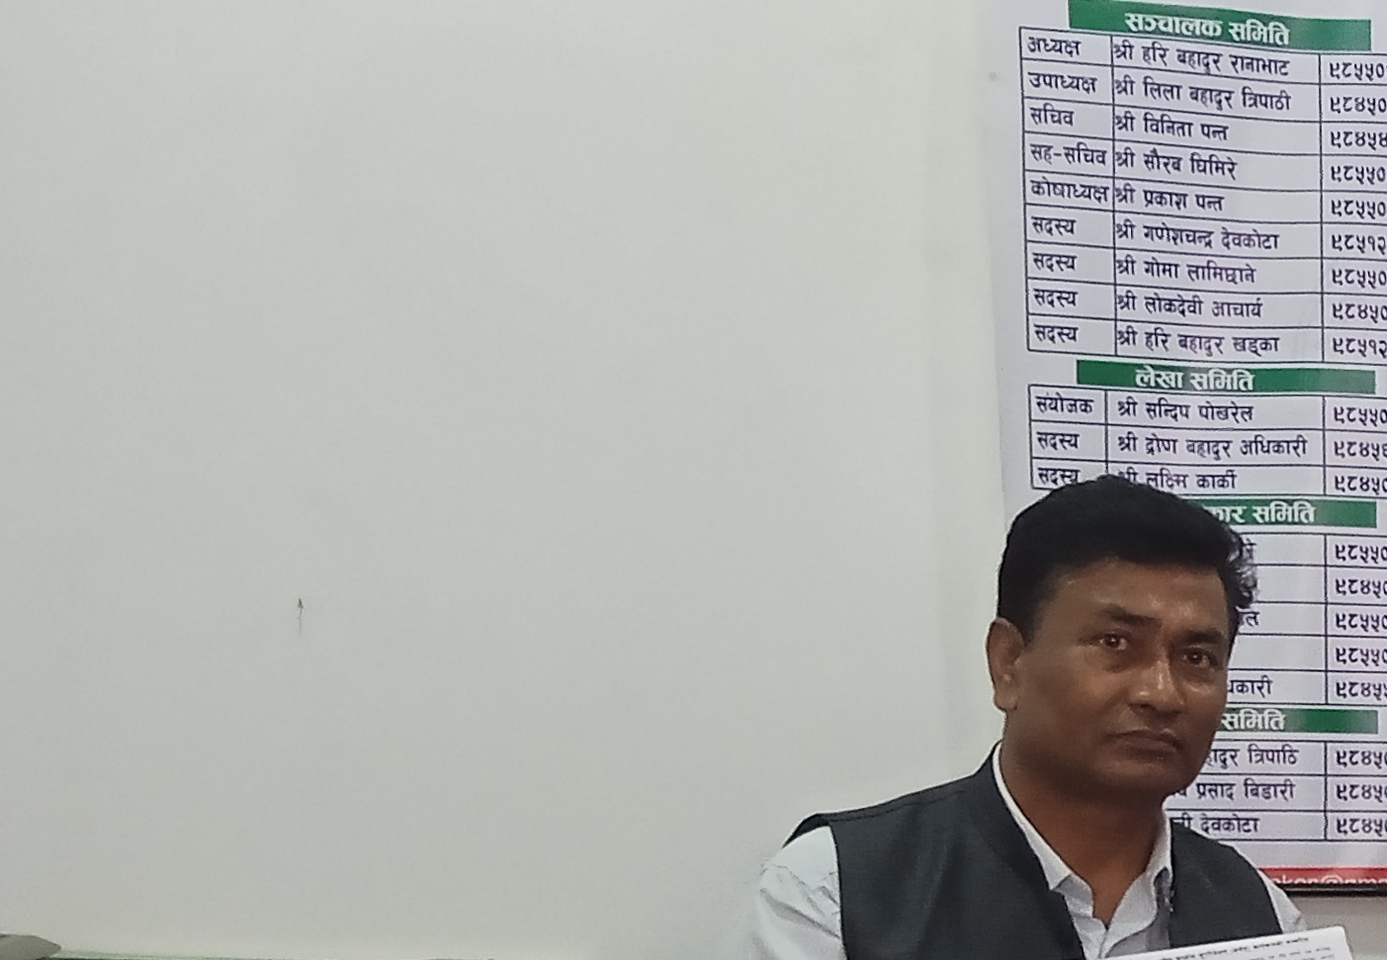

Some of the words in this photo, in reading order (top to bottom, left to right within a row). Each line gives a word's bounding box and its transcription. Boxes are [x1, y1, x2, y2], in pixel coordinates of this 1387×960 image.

[1123, 13, 1223, 39] सञ्चालक
[1228, 20, 1290, 45] समिति
[1028, 36, 1082, 58] अध्यक्ष
[1115, 39, 1135, 60] श्री
[1141, 41, 1170, 67] हरि
[1176, 48, 1224, 74] बहादुर
[1228, 54, 1290, 76] रानाभाट
[1027, 71, 1098, 94] उपाध्यक्ष
[1115, 74, 1136, 96] श्री
[1142, 75, 1183, 101] लिला
[1188, 86, 1235, 111] बहादुर
[1241, 86, 1292, 110] त्रिपाठी
[1029, 102, 1074, 126] सचिव
[1116, 110, 1136, 132] श्री
[1142, 111, 1194, 138] विनिता
[1200, 123, 1229, 141] पन्त
[1029, 141, 1108, 166] सह-सचिव
[1116, 146, 1136, 168] श्री
[1189, 152, 1238, 181] घिमिरे
[1030, 176, 1110, 204] कोषाध्यक्ष
[1116, 182, 1136, 204] श्री
[1142, 189, 1189, 211] प्रकाश
[1194, 194, 1225, 211] पन्त
[1030, 216, 1077, 236] सदस्य
[1117, 218, 1136, 240] श्री
[1142, 222, 1215, 249] गणेशचन्द्र
[1220, 226, 1280, 250] देवकोटा
[1032, 252, 1078, 272] सदस्य
[1118, 254, 1137, 276] श्री
[1143, 256, 1181, 279] गोमा
[1186, 259, 1257, 285] लामिछाने
[1033, 288, 1078, 309] सदस्य
[1118, 289, 1138, 311] श्री
[1144, 292, 1204, 318] लोकदेवी
[1212, 297, 1263, 318] आचार्य
[1034, 324, 1079, 344] सदस्य
[1118, 325, 1138, 346] श्री
[1144, 326, 1172, 352] हरि
[1177, 333, 1225, 357] बहादुर
[1231, 337, 1280, 357] खड्का
[1135, 368, 1184, 391] लेखा
[1190, 370, 1254, 391] समिति
[1035, 392, 1095, 414] संयोजक
[1117, 396, 1138, 417] श्री
[1197, 400, 1254, 424] पोखरेल
[1036, 431, 1080, 451] सदस्य
[1118, 431, 1138, 452] श्री
[1185, 439, 1233, 461] बहादुर
[1240, 434, 1308, 458] अधिकारी
